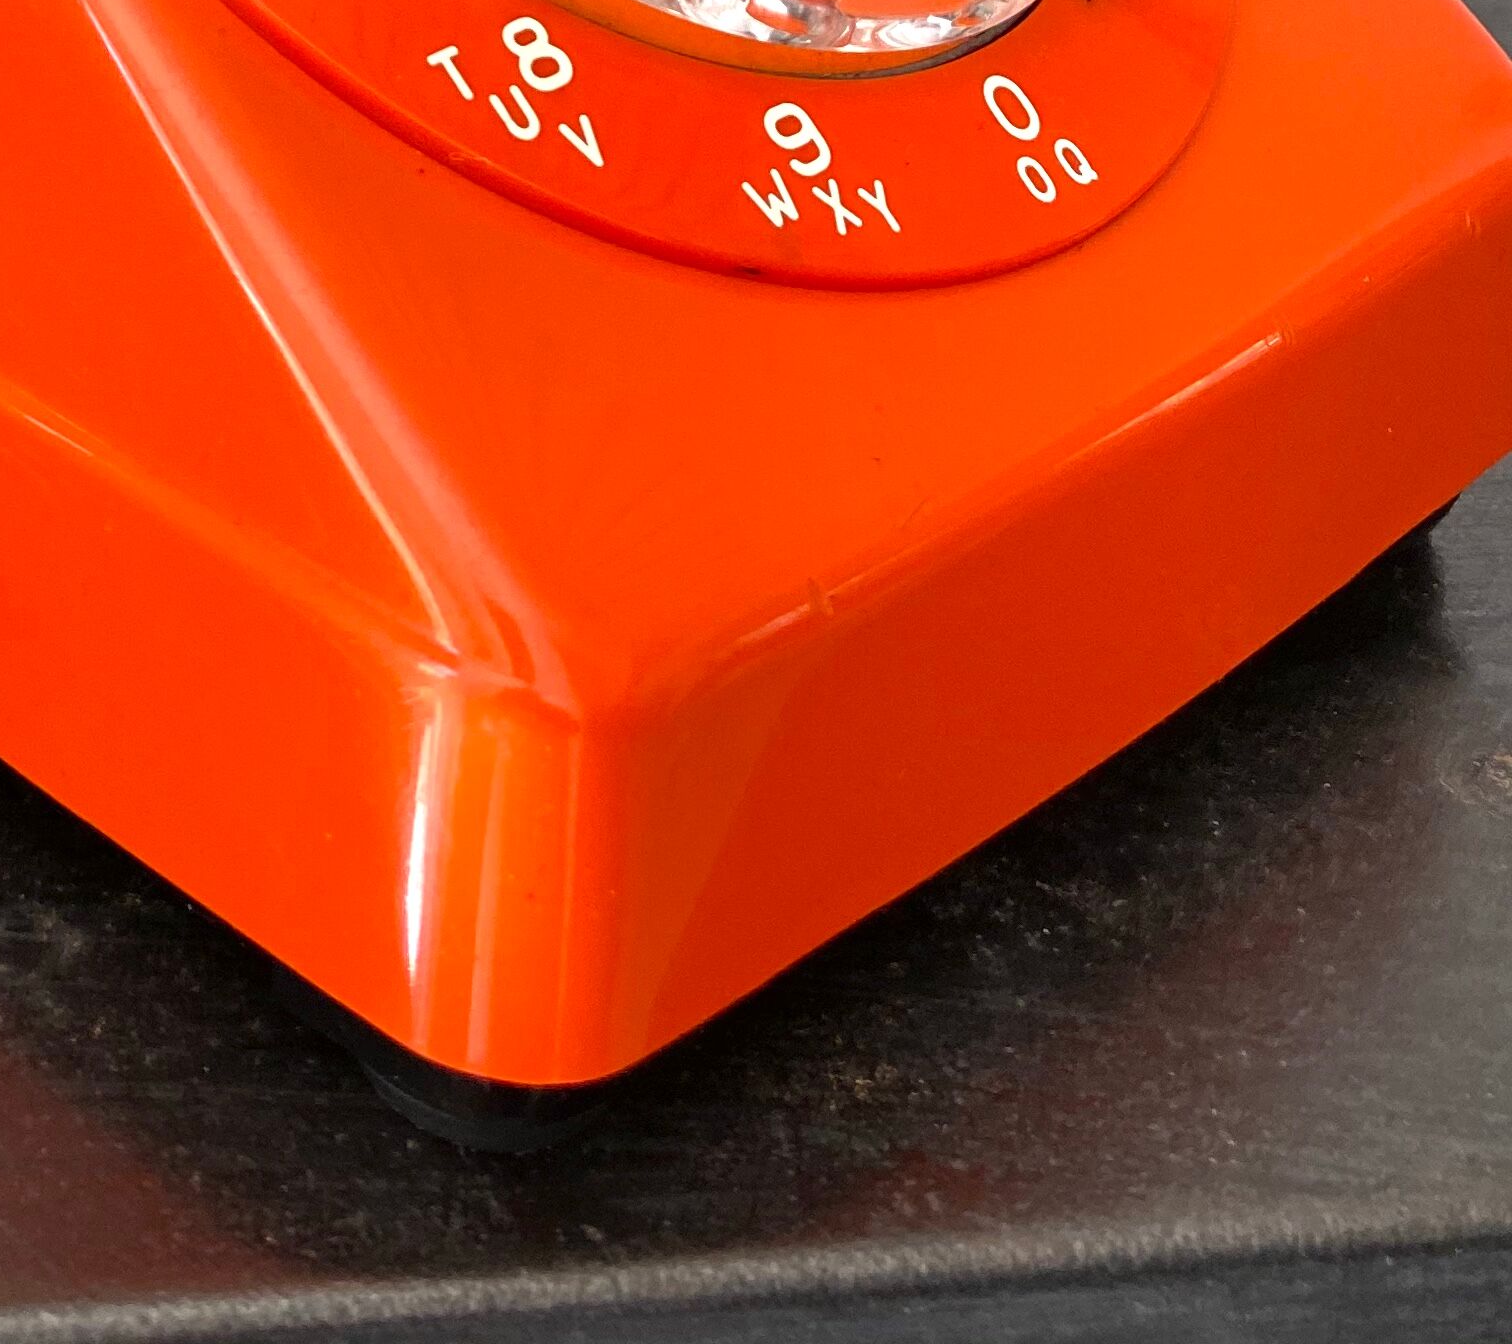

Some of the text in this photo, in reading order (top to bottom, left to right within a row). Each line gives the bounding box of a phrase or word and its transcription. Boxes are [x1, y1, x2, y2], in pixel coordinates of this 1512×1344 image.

[500, 14, 575, 93] 8
[762, 101, 833, 178] 9
[982, 74, 1042, 143] 0
[741, 178, 902, 236] WXY
